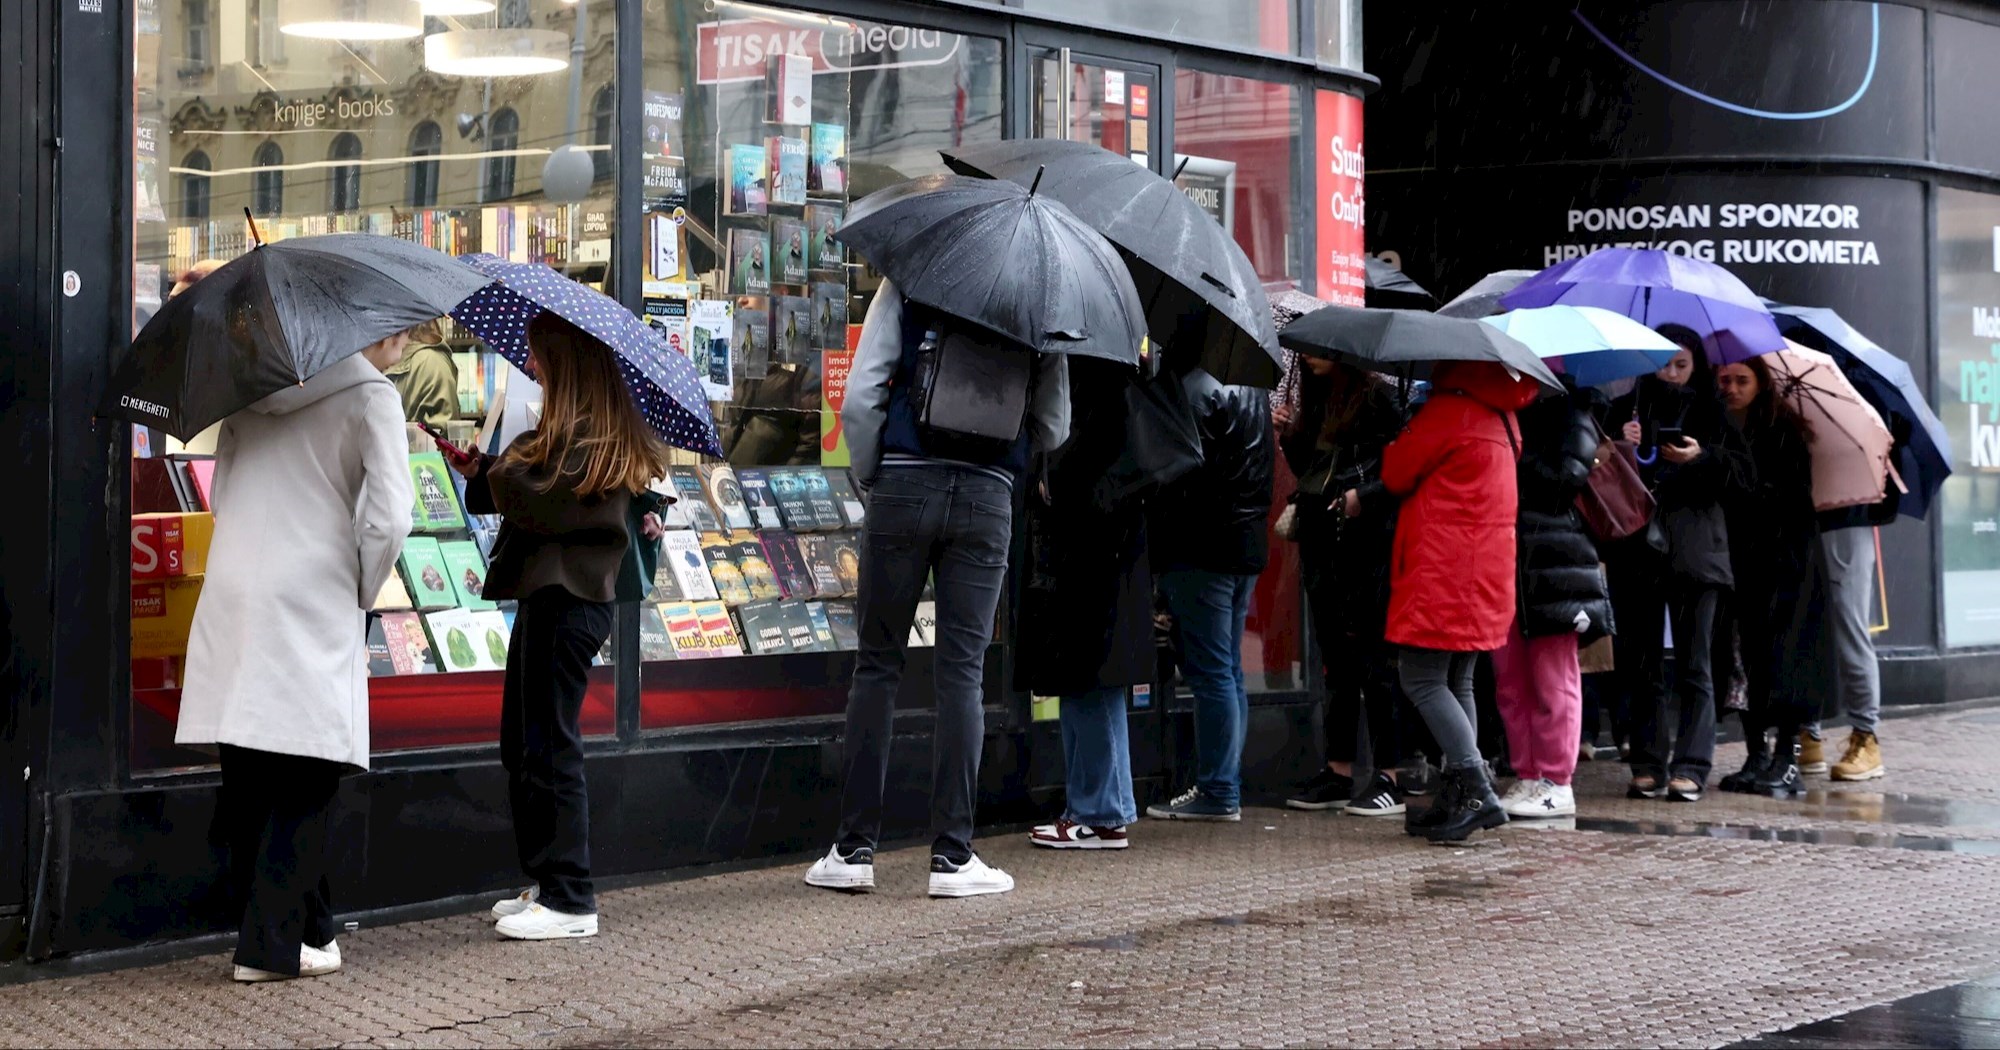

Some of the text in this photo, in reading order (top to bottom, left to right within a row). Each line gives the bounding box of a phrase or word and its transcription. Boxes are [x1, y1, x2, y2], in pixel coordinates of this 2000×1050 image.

[713, 30, 810, 68] TISAK
[274, 93, 394, 127] knjige books
[651, 165, 677, 177] FREIDA
[644, 175, 683, 189] McFADDEN
[1331, 191, 1359, 230] Only
[586, 213, 605, 222] GRAD
[1567, 203, 1859, 232] PONOSAN SPONZOR
[819, 251, 841, 263] Adam
[1723, 239, 1880, 265] RUKOMETA
[784, 264, 806, 277] Adam
[746, 276, 769, 289] Adam
[645, 305, 686, 316] HOLLY JACKSON
[130, 397, 170, 420] MENEGHETTI
[133, 597, 161, 606] TISAK
